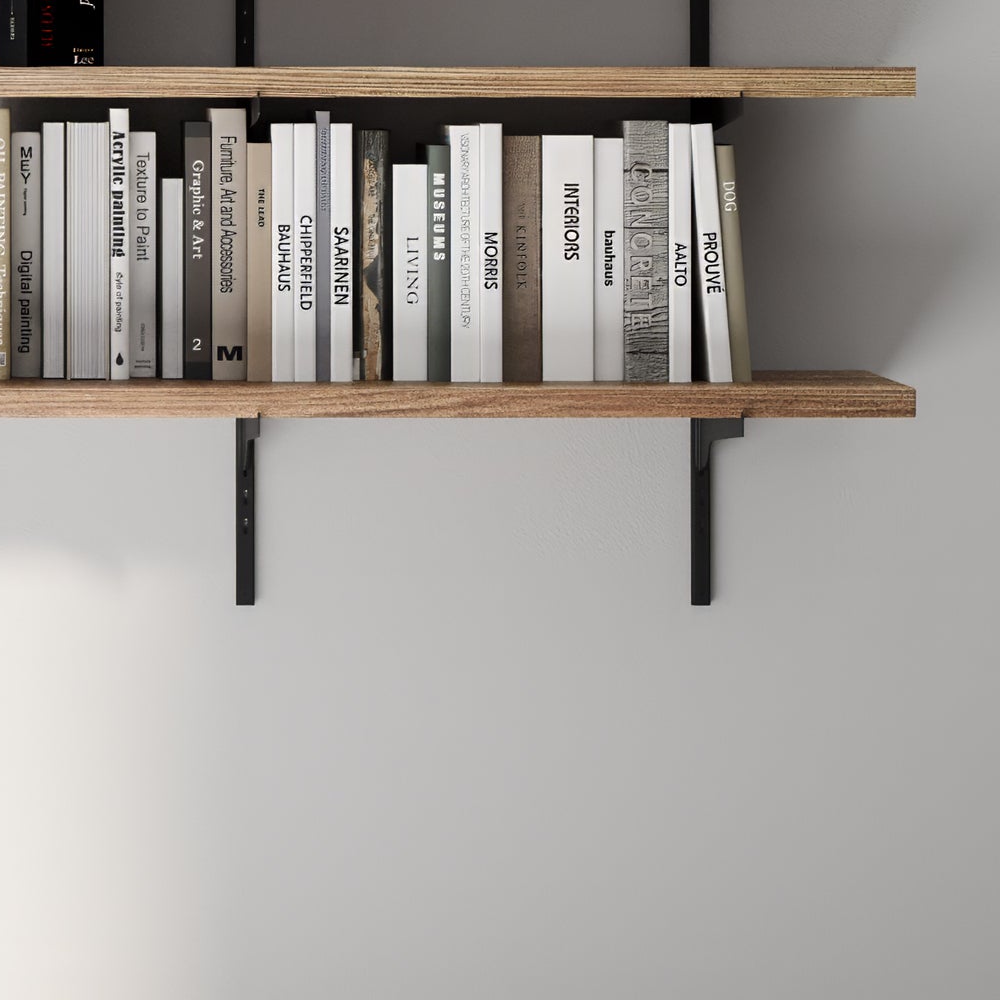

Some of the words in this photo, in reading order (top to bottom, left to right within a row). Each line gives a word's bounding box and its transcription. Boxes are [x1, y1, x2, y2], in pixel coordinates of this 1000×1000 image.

[111, 131, 126, 186] Acrylic
[136, 152, 151, 204] Texture
[219, 136, 237, 186] Furniture,
[189, 160, 205, 215] Graphic
[220, 188, 237, 204] Art
[257, 188, 265, 204] THE
[723, 181, 737, 213] DOG
[111, 190, 126, 258] painting
[136, 208, 149, 221] to
[192, 219, 204, 231] &
[220, 206, 237, 226] and
[257, 207, 265, 228] LEAD
[432, 172, 445, 261] MUSEUMS
[564, 183, 580, 261] INTERIORS
[136, 226, 151, 261] Paint
[192, 234, 204, 259] Art
[219, 229, 237, 293] Accessories
[277, 224, 291, 292] BAUHAUS
[299, 215, 313, 311] CHIPPERFIELD
[333, 226, 349, 305] SAARINEN
[484, 232, 498, 290] MORRIS
[516, 225, 527, 290] KINFOLK
[604, 230, 616, 287] bauhaus
[674, 243, 687, 287] AALTO
[702, 232, 725, 294] PROUVÉ
[18, 250, 33, 294] Digital
[406, 237, 419, 305] LIVING
[17, 299, 33, 354] painting
[114, 301, 123, 333] painting
[192, 338, 201, 351] 2
